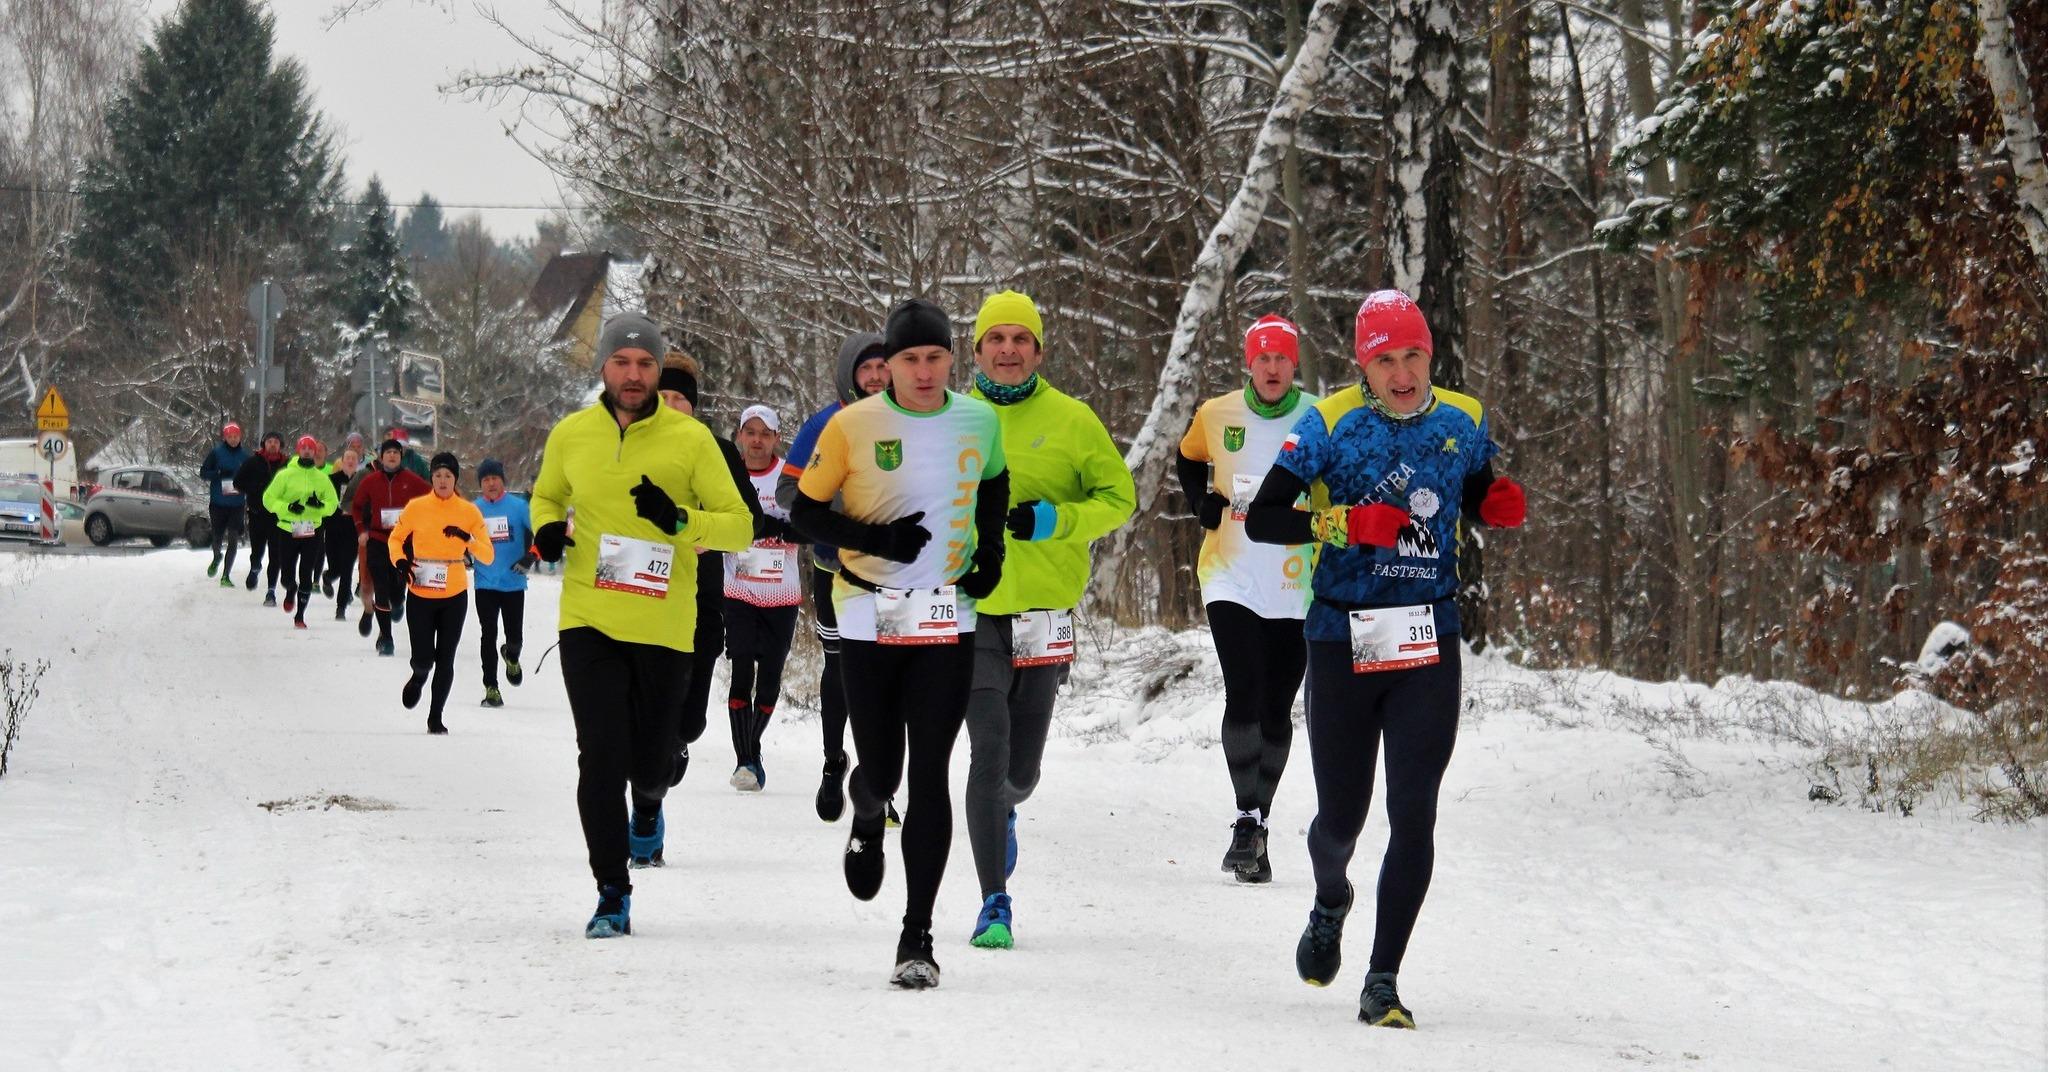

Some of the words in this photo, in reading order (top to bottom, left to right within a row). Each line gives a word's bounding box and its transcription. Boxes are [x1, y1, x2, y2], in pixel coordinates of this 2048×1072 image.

[43, 439, 64, 454] 40
[648, 560, 669, 576] 472
[930, 604, 954, 620] 276
[1056, 625, 1071, 641] 388
[1409, 624, 1434, 642] 319
